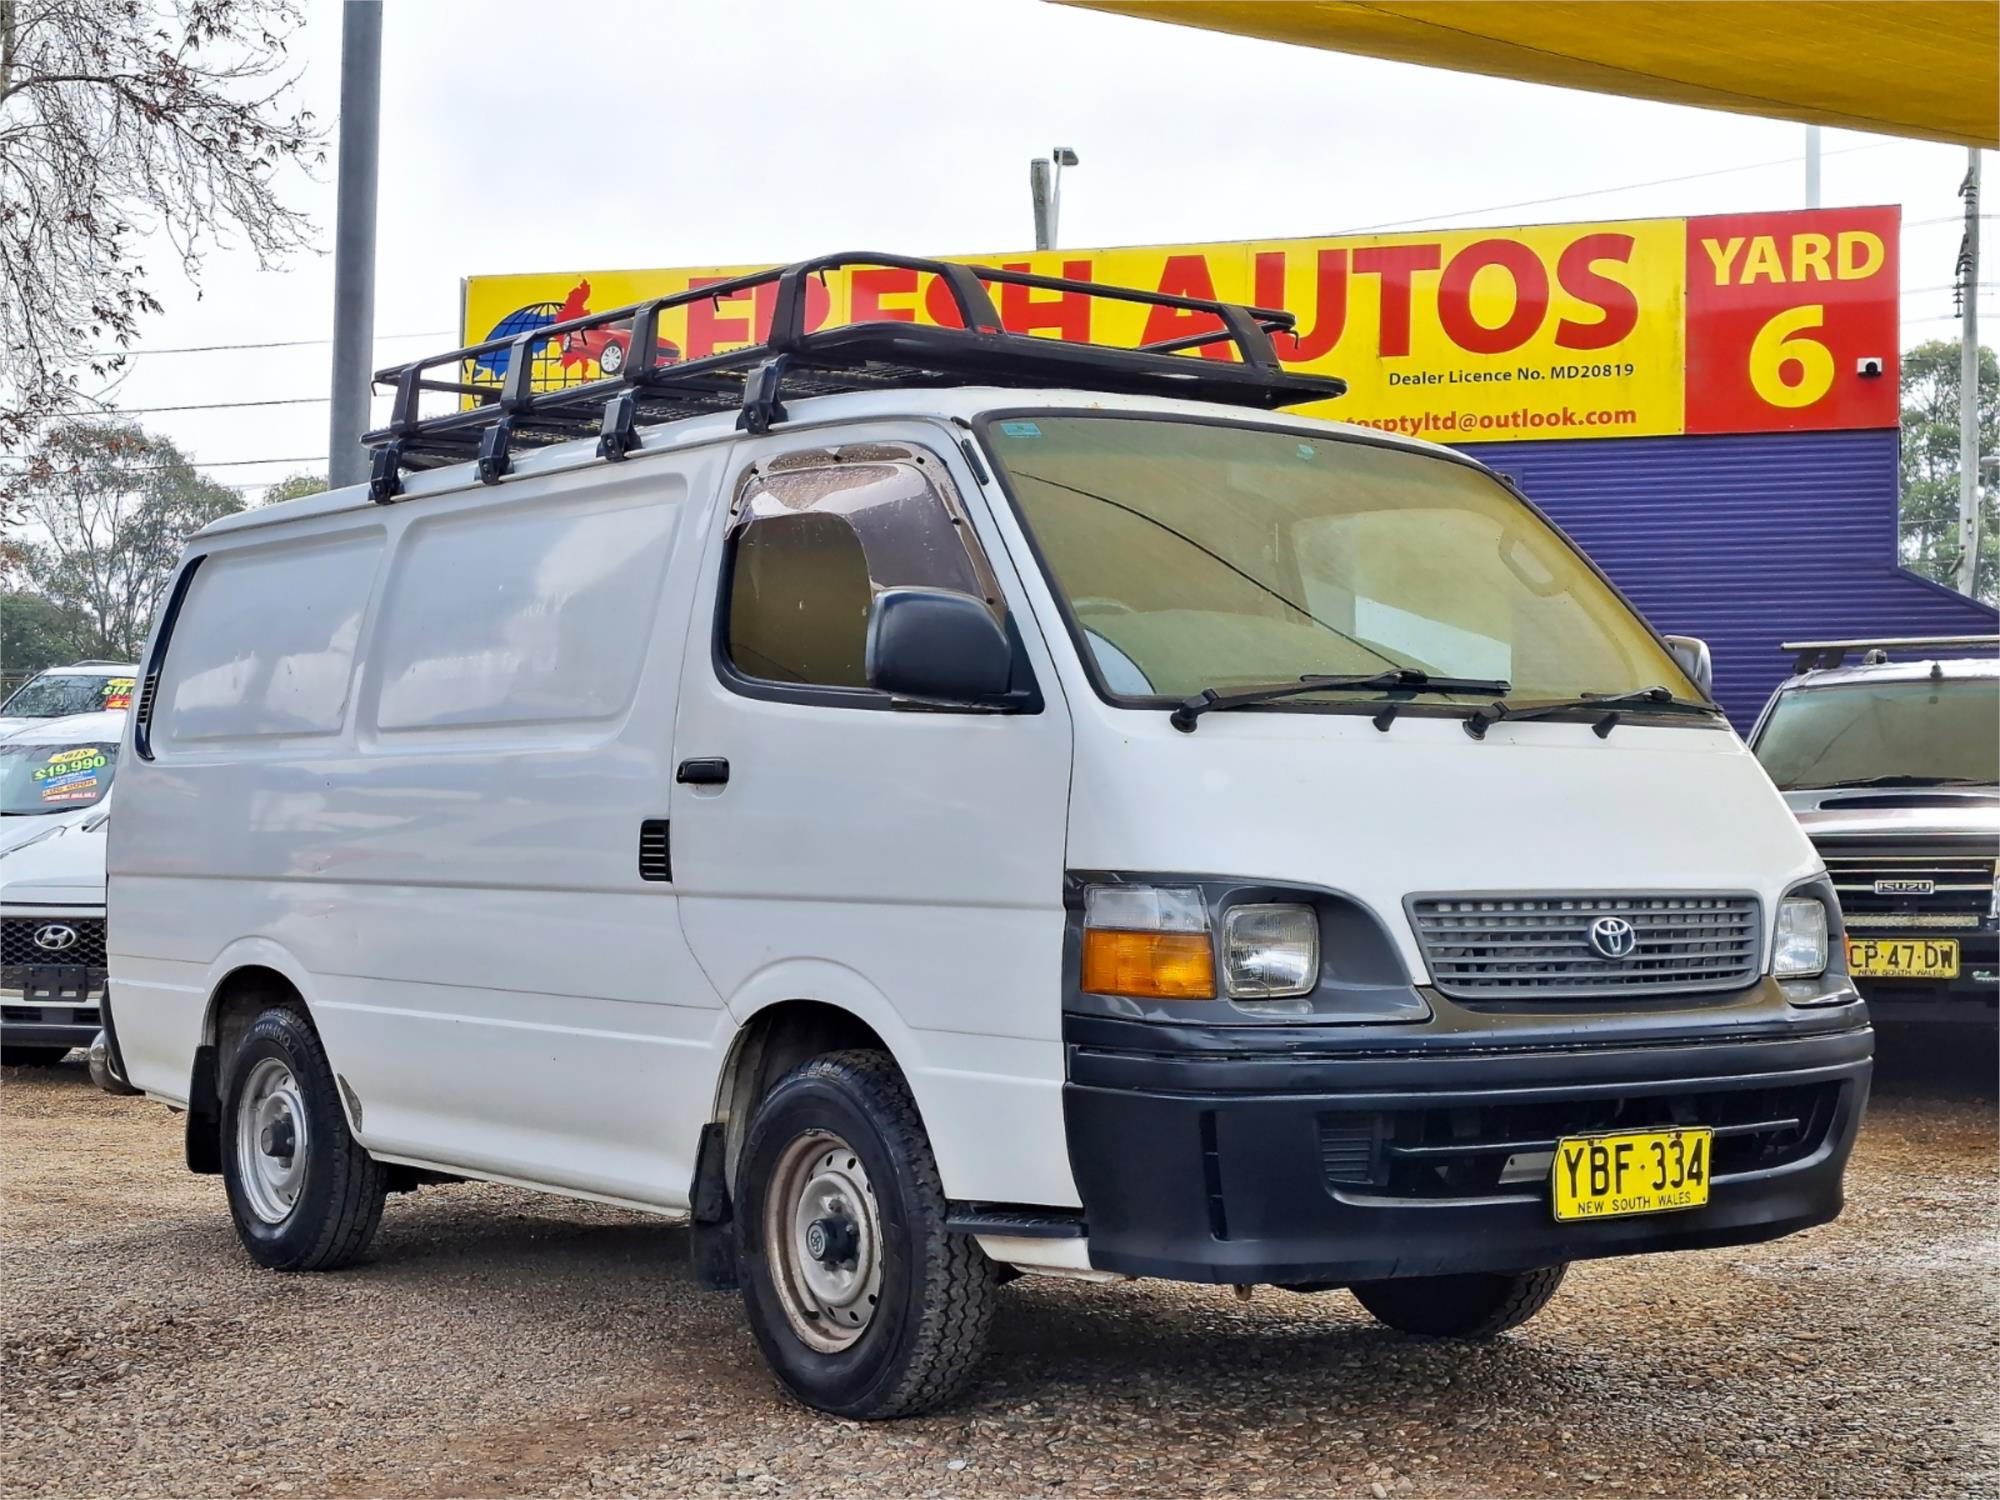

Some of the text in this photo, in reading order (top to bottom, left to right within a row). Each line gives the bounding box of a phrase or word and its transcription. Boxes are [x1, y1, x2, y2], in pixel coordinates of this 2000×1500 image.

[1701, 230, 1886, 286] YARD
[1137, 231, 1639, 363] AUTOS
[1389, 363, 1634, 386] Dealer Licence No. MD20819
[1749, 304, 1835, 409] 6
[1879, 882, 1930, 892] ISUZU
[1577, 1191, 1692, 1215] NEW SOUTH WALES
